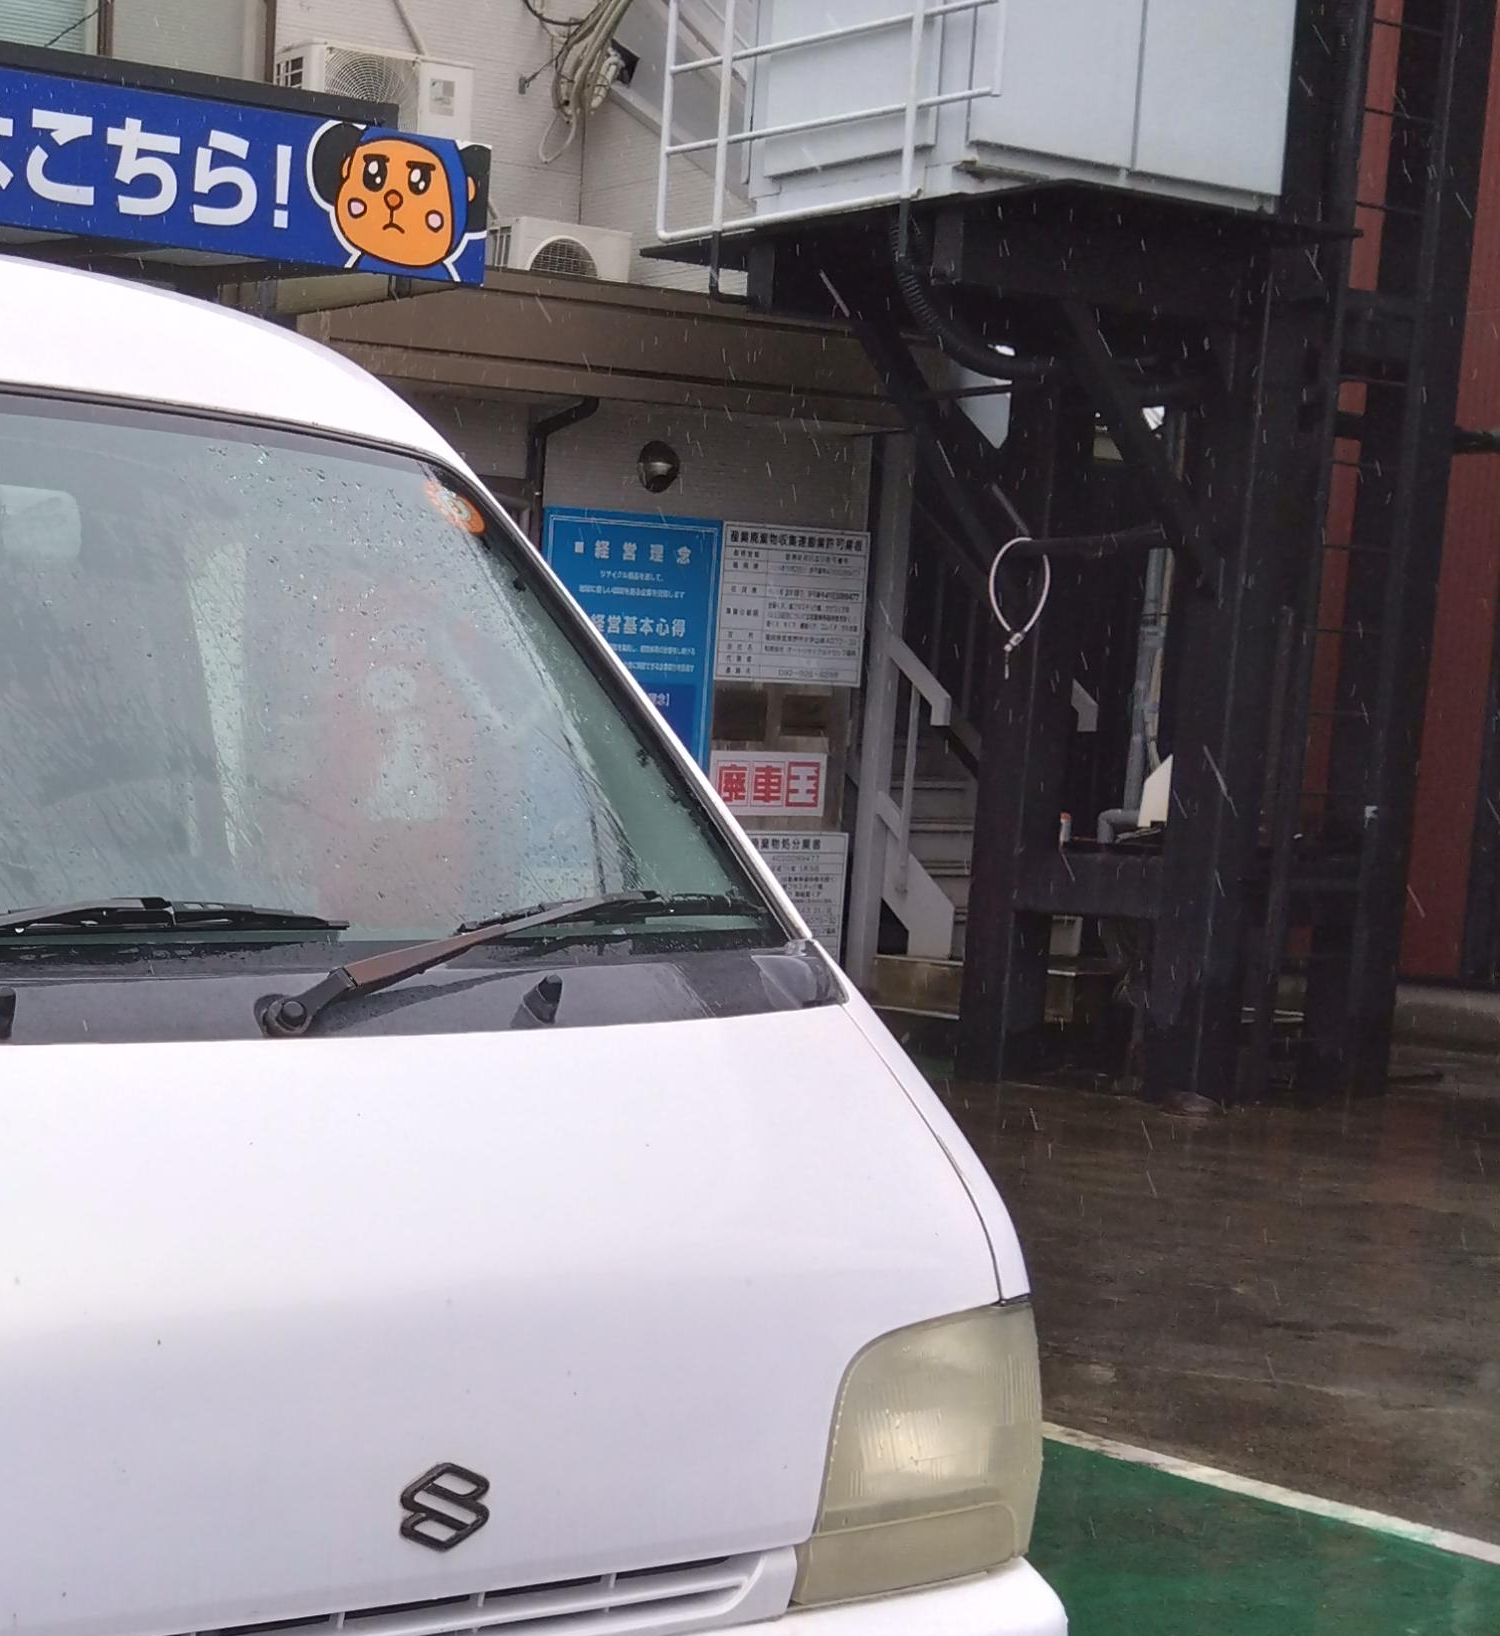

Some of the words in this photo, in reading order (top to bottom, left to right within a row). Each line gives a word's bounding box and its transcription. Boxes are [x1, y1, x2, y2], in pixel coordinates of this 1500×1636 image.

[594, 539, 692, 565] 経営理念
[590, 614, 687, 638] 経営基本心得
